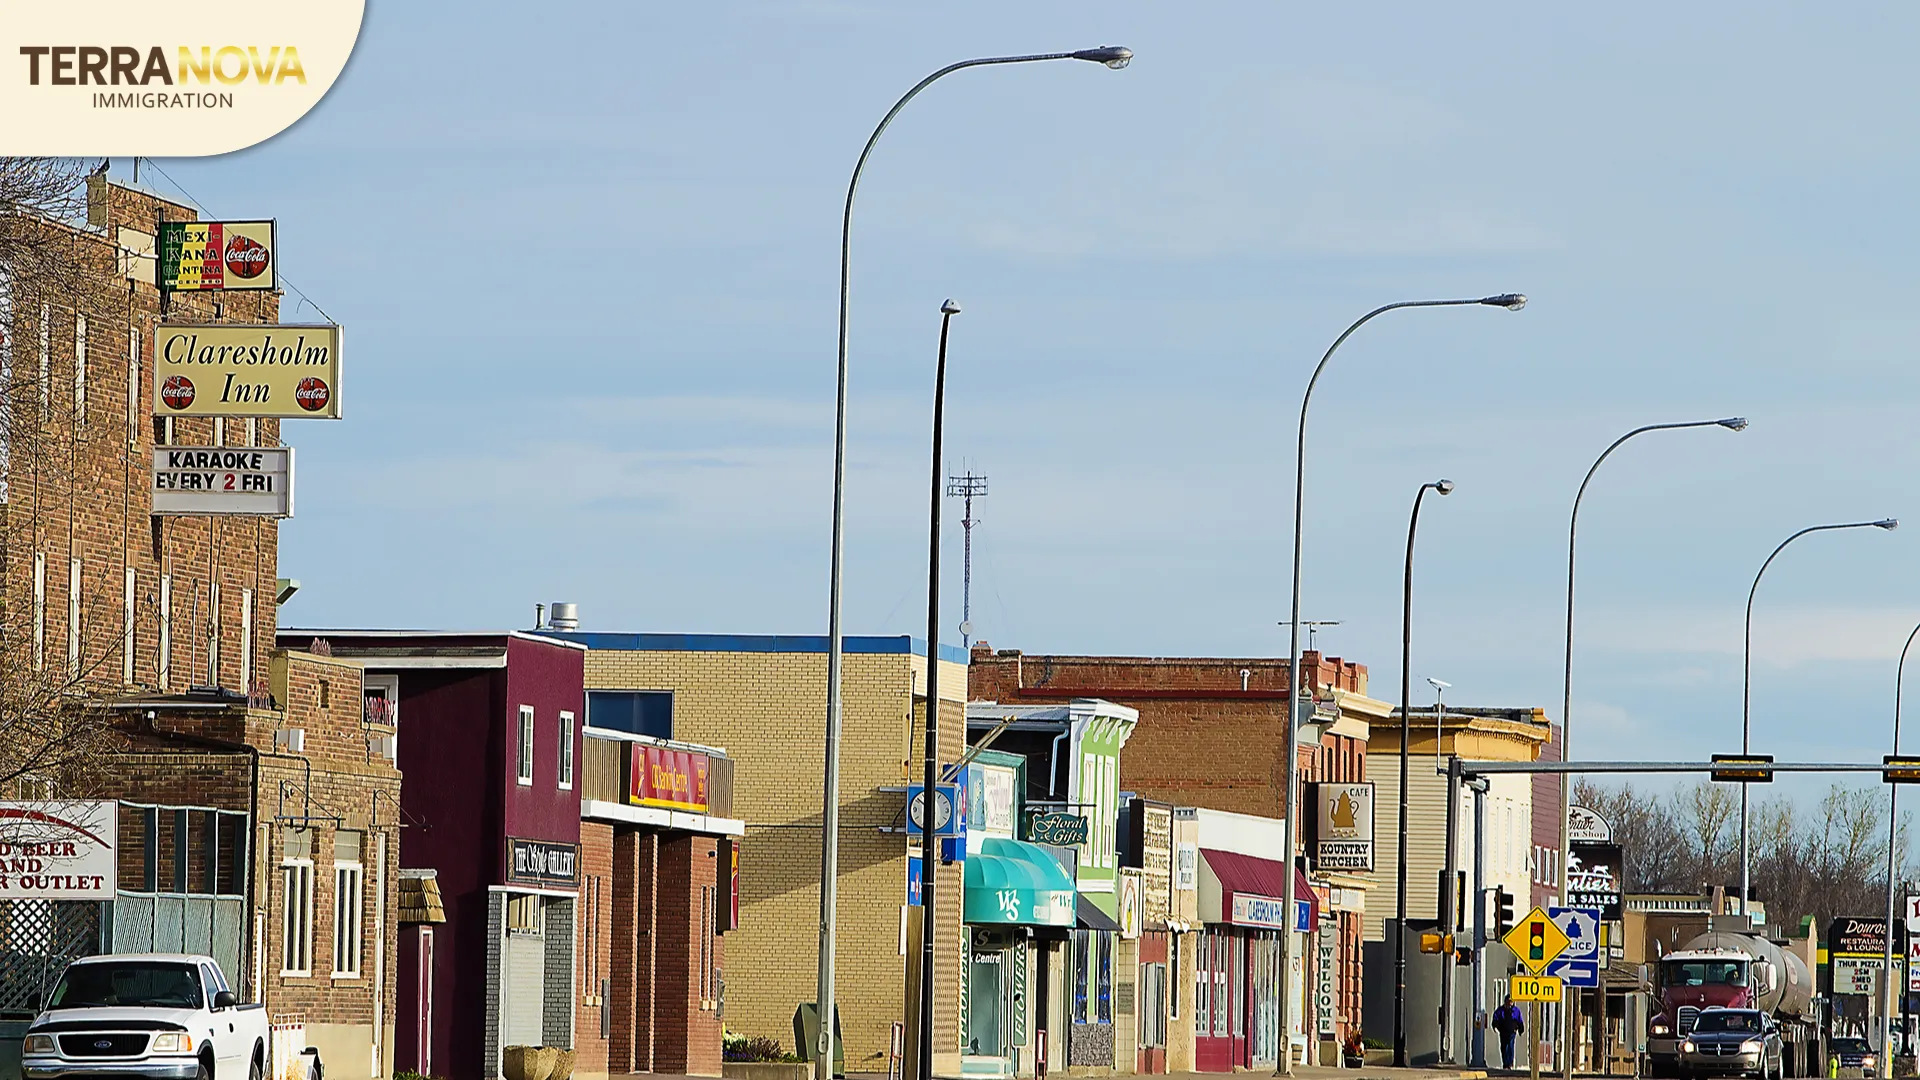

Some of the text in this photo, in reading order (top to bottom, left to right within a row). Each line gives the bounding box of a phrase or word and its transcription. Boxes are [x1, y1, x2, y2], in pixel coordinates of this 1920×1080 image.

[165, 247, 219, 262] KANA
[163, 264, 222, 276] CANTINA
[163, 334, 329, 366] Claresholm
[219, 373, 271, 403] Inn
[169, 451, 263, 470] KARAOKE
[156, 472, 272, 492] EVERY 2 FRI
[1350, 788, 1369, 797] CAFE
[1035, 815, 1085, 833] Floral
[1050, 829, 1083, 844] Gifts
[1582, 831, 1606, 839] Shop
[22, 842, 77, 856] BEER
[1320, 844, 1369, 855] KOUNTRY
[515, 847, 526, 872] THE
[548, 850, 575, 876] GALLERY
[1320, 857, 1368, 867] KITCHEN
[20, 875, 104, 890] OUTLET
[1580, 894, 1618, 905] SALES
[1569, 942, 1592, 950] LICE
[1840, 938, 1897, 946] RESTAURAT
[975, 952, 1000, 964] Centre
[1838, 960, 1857, 968] THUR
[1860, 960, 1881, 968] PIZZA
[1014, 938, 1025, 1039] FLOWERS
[1320, 947, 1333, 1030] WELCOME
[1518, 981, 1555, 996] 110 m
